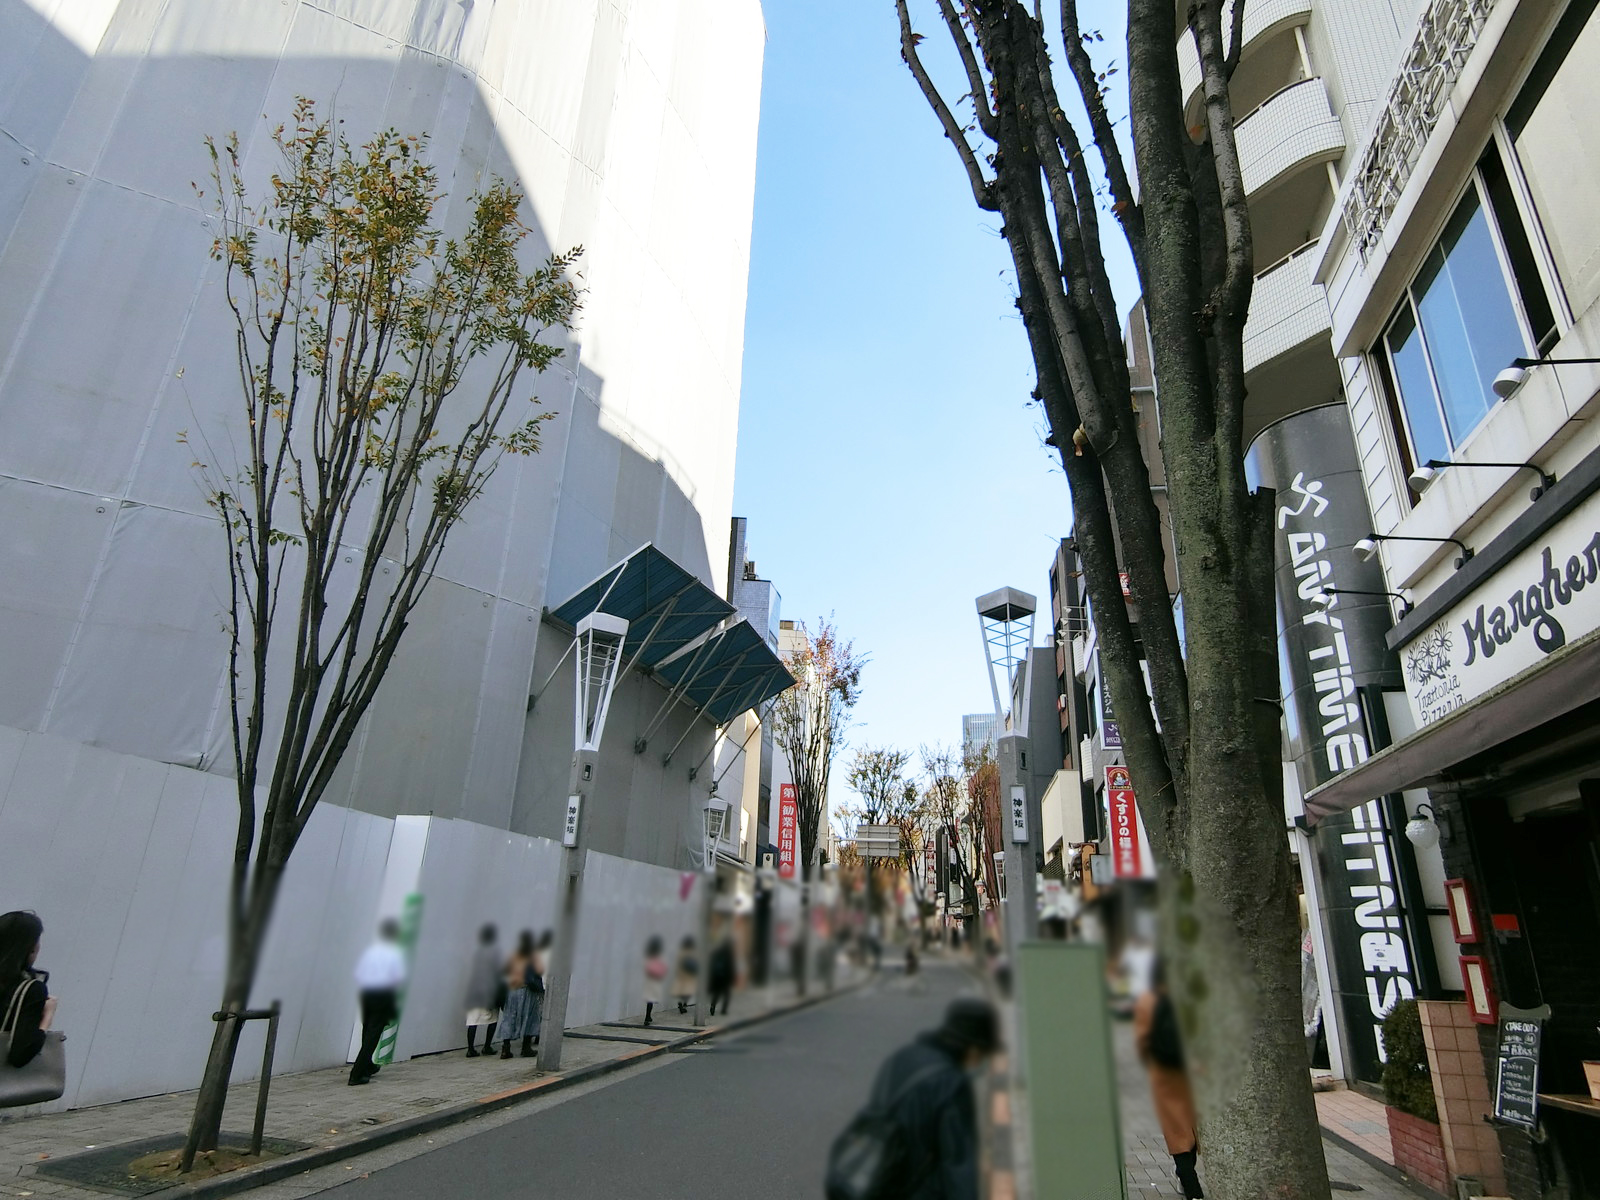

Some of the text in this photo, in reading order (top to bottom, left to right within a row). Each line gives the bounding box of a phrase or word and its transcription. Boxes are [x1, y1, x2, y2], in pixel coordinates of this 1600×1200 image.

[1414, 673, 1461, 711] Trattoria
[566, 806, 577, 834] 神楽坂
[1012, 798, 1024, 828] 神楽坂
[1341, 799, 1414, 1064] FITNES
